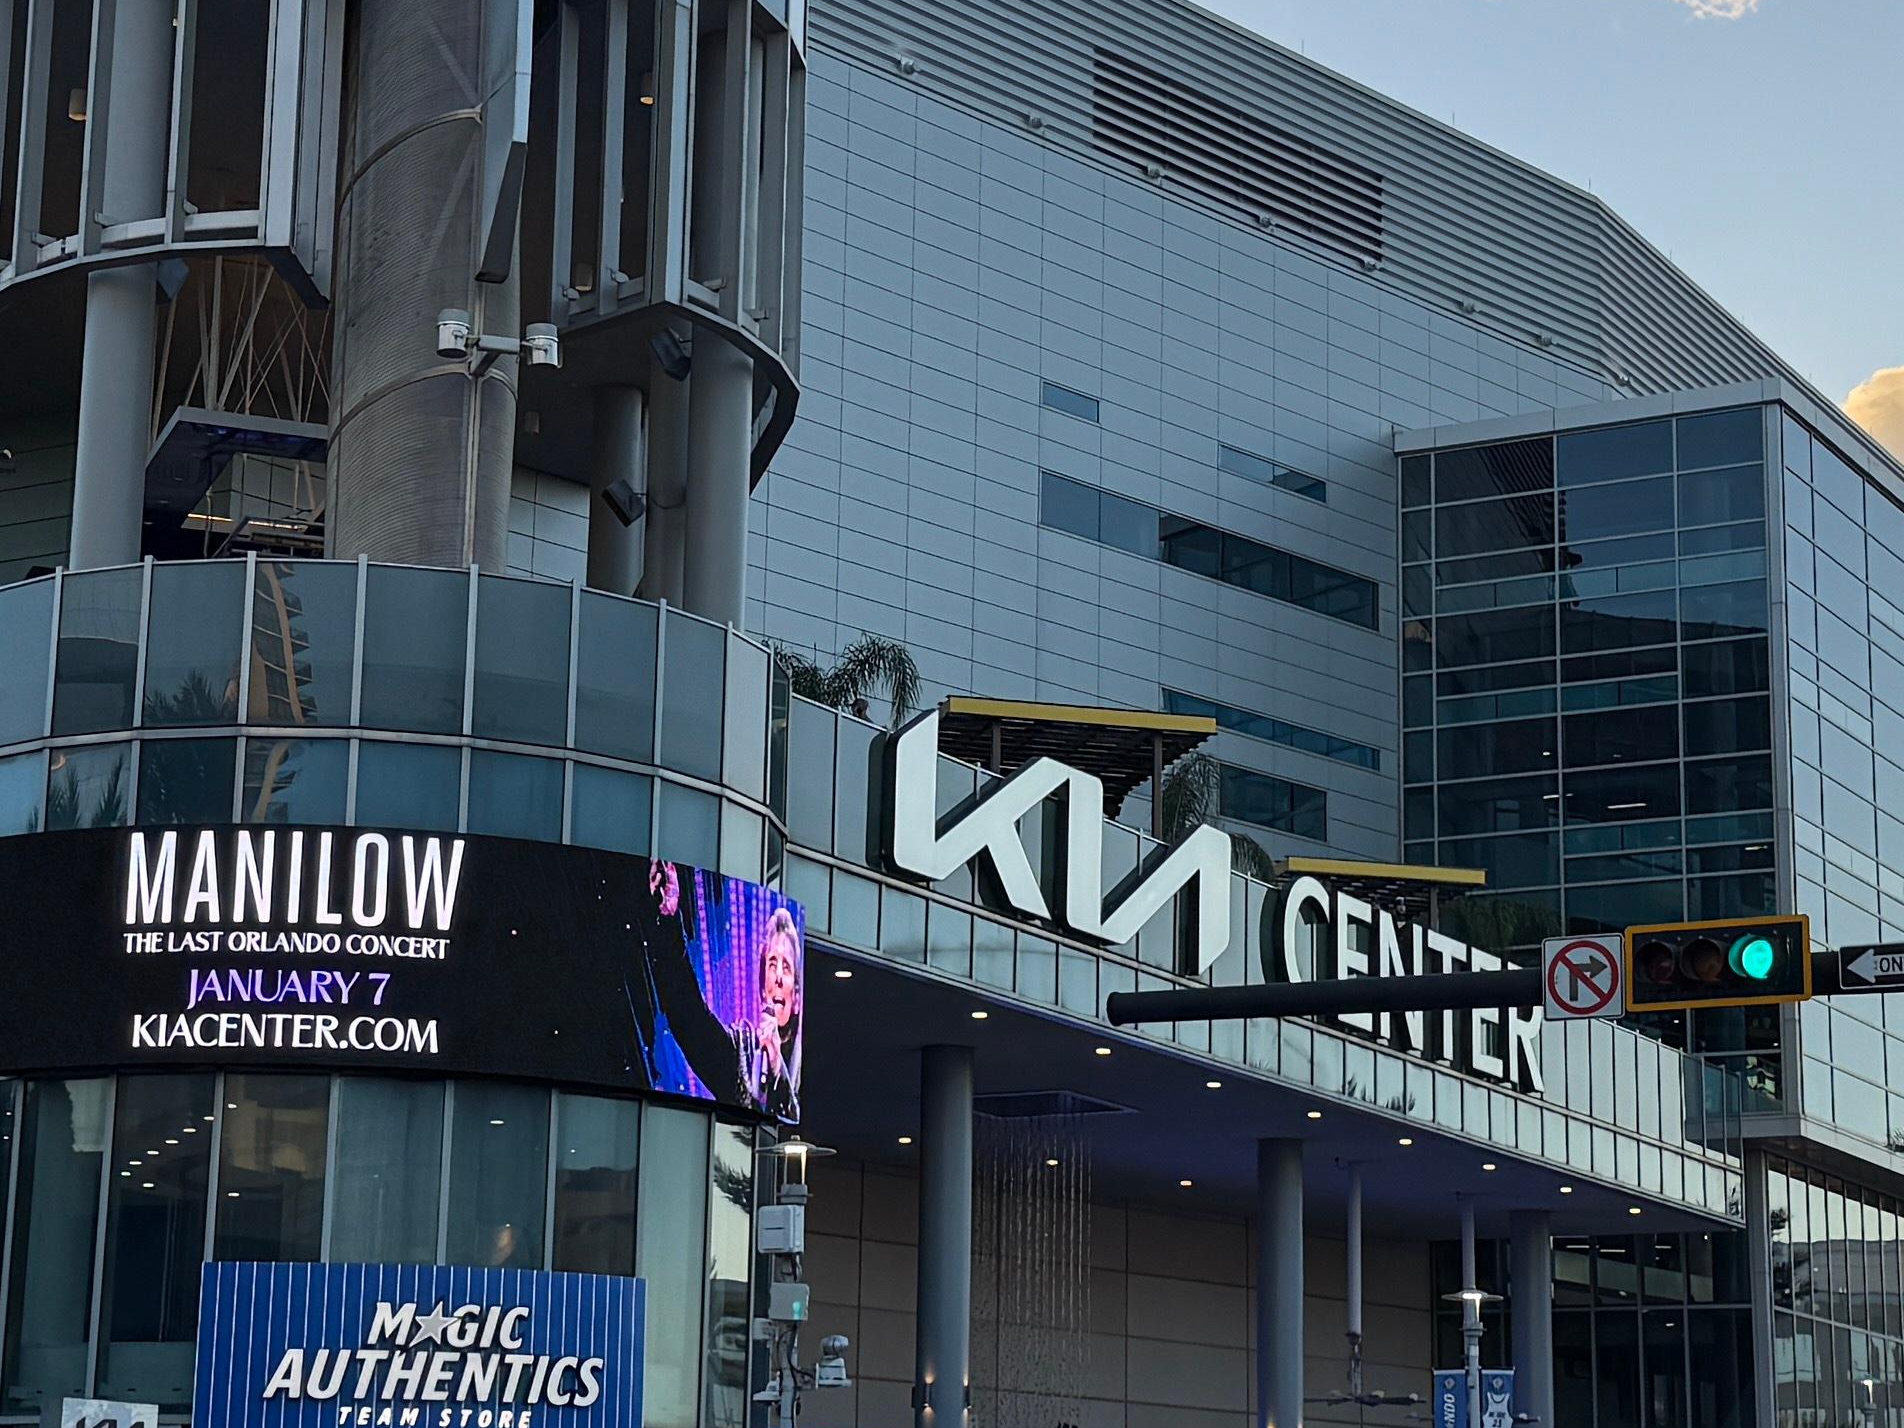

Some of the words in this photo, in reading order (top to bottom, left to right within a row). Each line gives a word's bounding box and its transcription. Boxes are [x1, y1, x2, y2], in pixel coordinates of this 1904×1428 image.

[125, 830, 466, 932] MANILOW
[124, 933, 164, 954] THE
[168, 931, 224, 953] LAST
[227, 931, 342, 954] ORLANDO
[346, 934, 451, 960] CONCERT
[186, 969, 361, 1010] JANUARY
[368, 973, 392, 1006] 7
[1276, 874, 1545, 1094] CENTER
[132, 1013, 440, 1054] KIACENTER.COM
[262, 1348, 604, 1407] AUTHENTICS
[338, 1406, 420, 1427] TEAM
